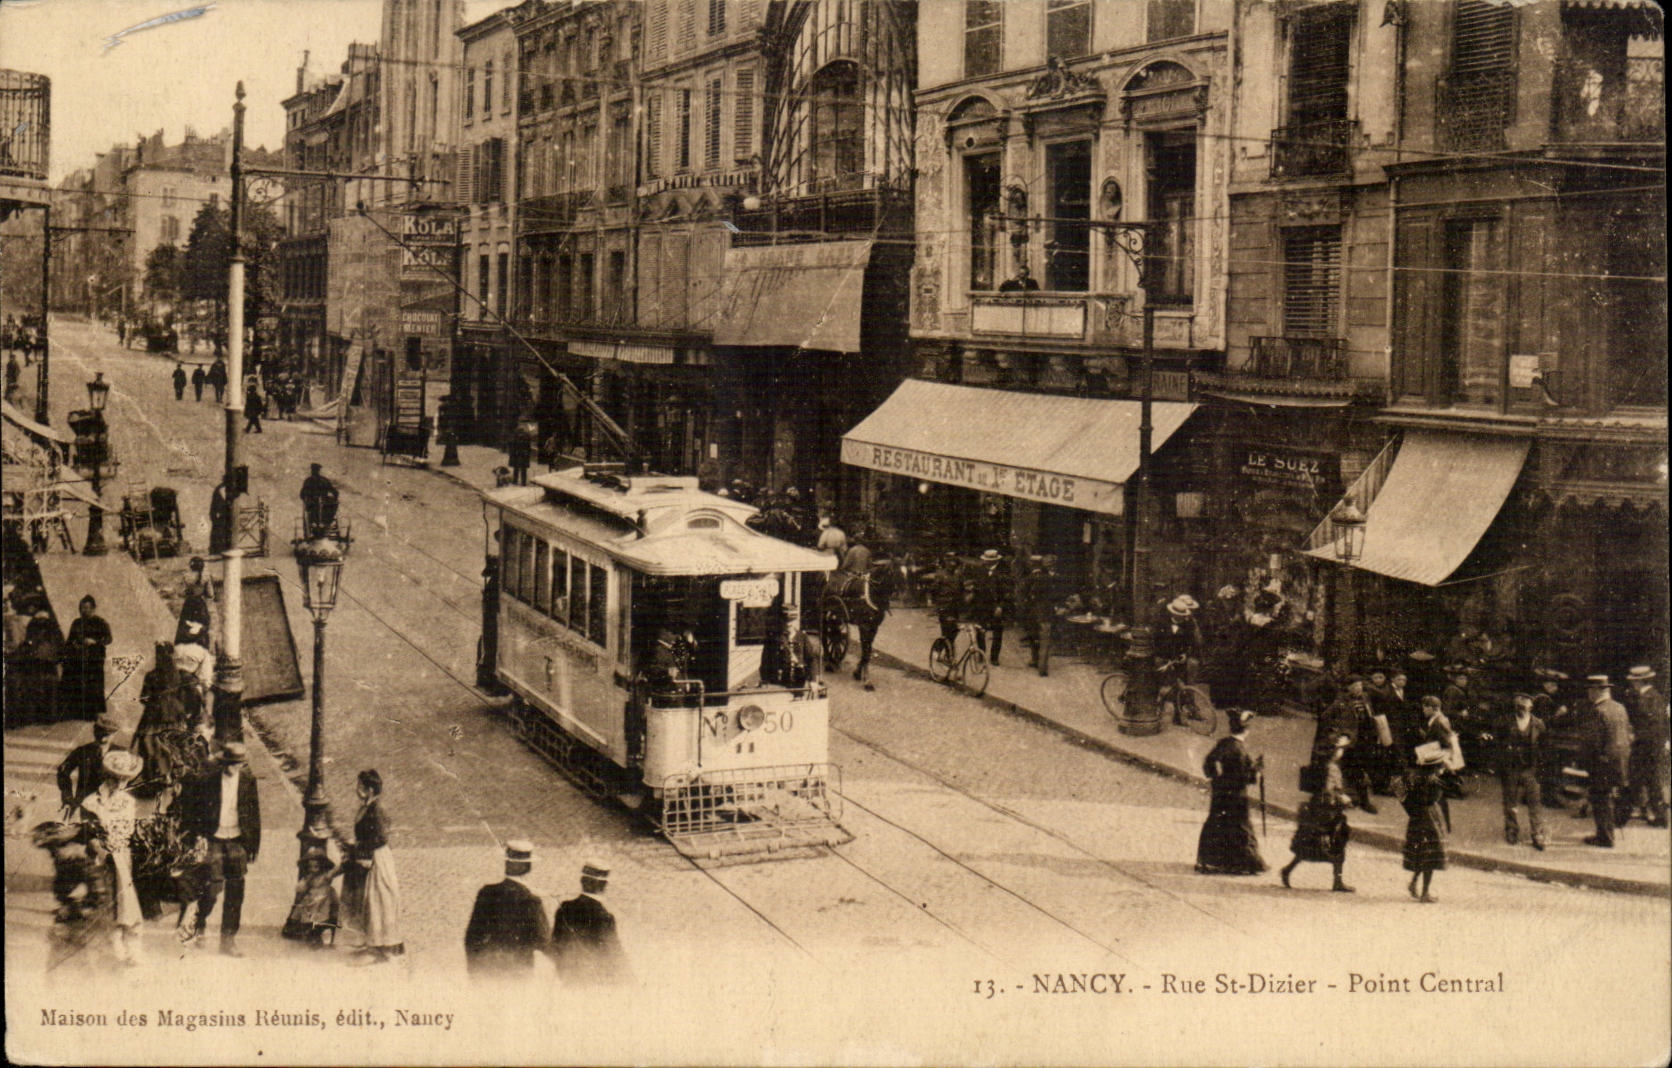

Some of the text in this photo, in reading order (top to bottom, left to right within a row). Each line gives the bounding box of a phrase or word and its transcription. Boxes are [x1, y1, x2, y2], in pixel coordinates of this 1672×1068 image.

[872, 447, 976, 484] RESTAURANT
[1014, 468, 1075, 502] ETAGE
[1248, 453, 1320, 473] LE SUEZ
[763, 710, 794, 734] 50
